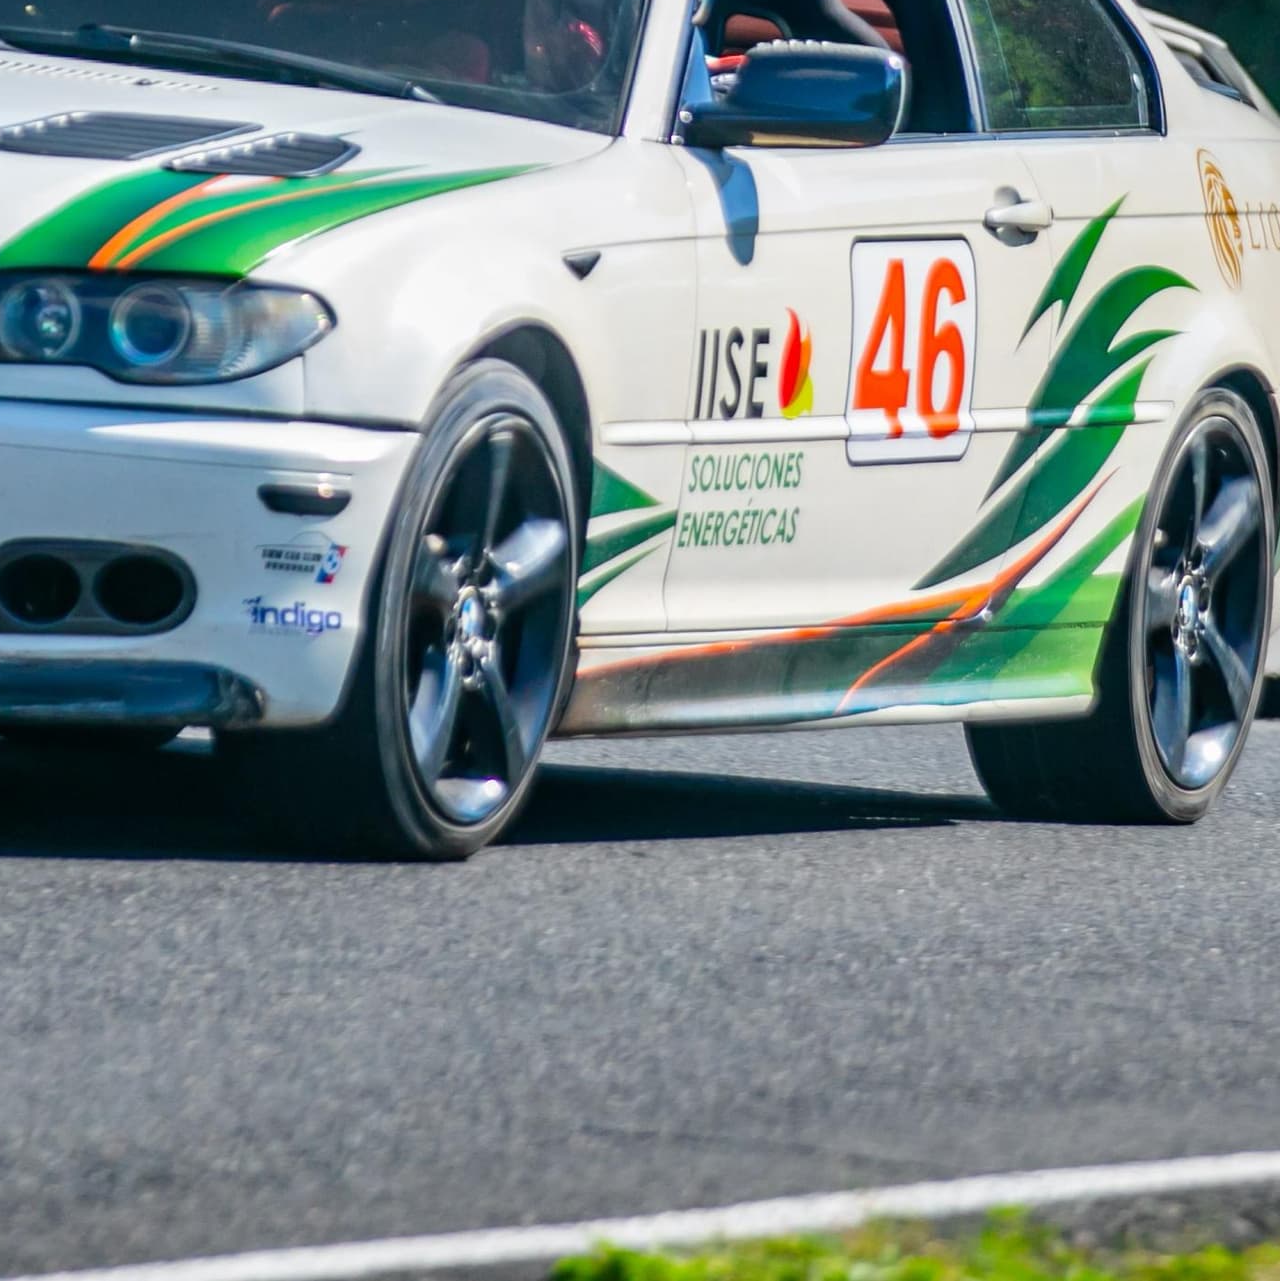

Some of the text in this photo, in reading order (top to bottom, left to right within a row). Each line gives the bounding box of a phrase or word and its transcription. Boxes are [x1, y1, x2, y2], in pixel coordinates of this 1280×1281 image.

[853, 257, 966, 439] 46
[694, 327, 770, 419] IISE
[688, 452, 804, 492] SOLUCIONES
[677, 499, 800, 548] ENERGÉTICAS
[251, 597, 342, 634] indigo
